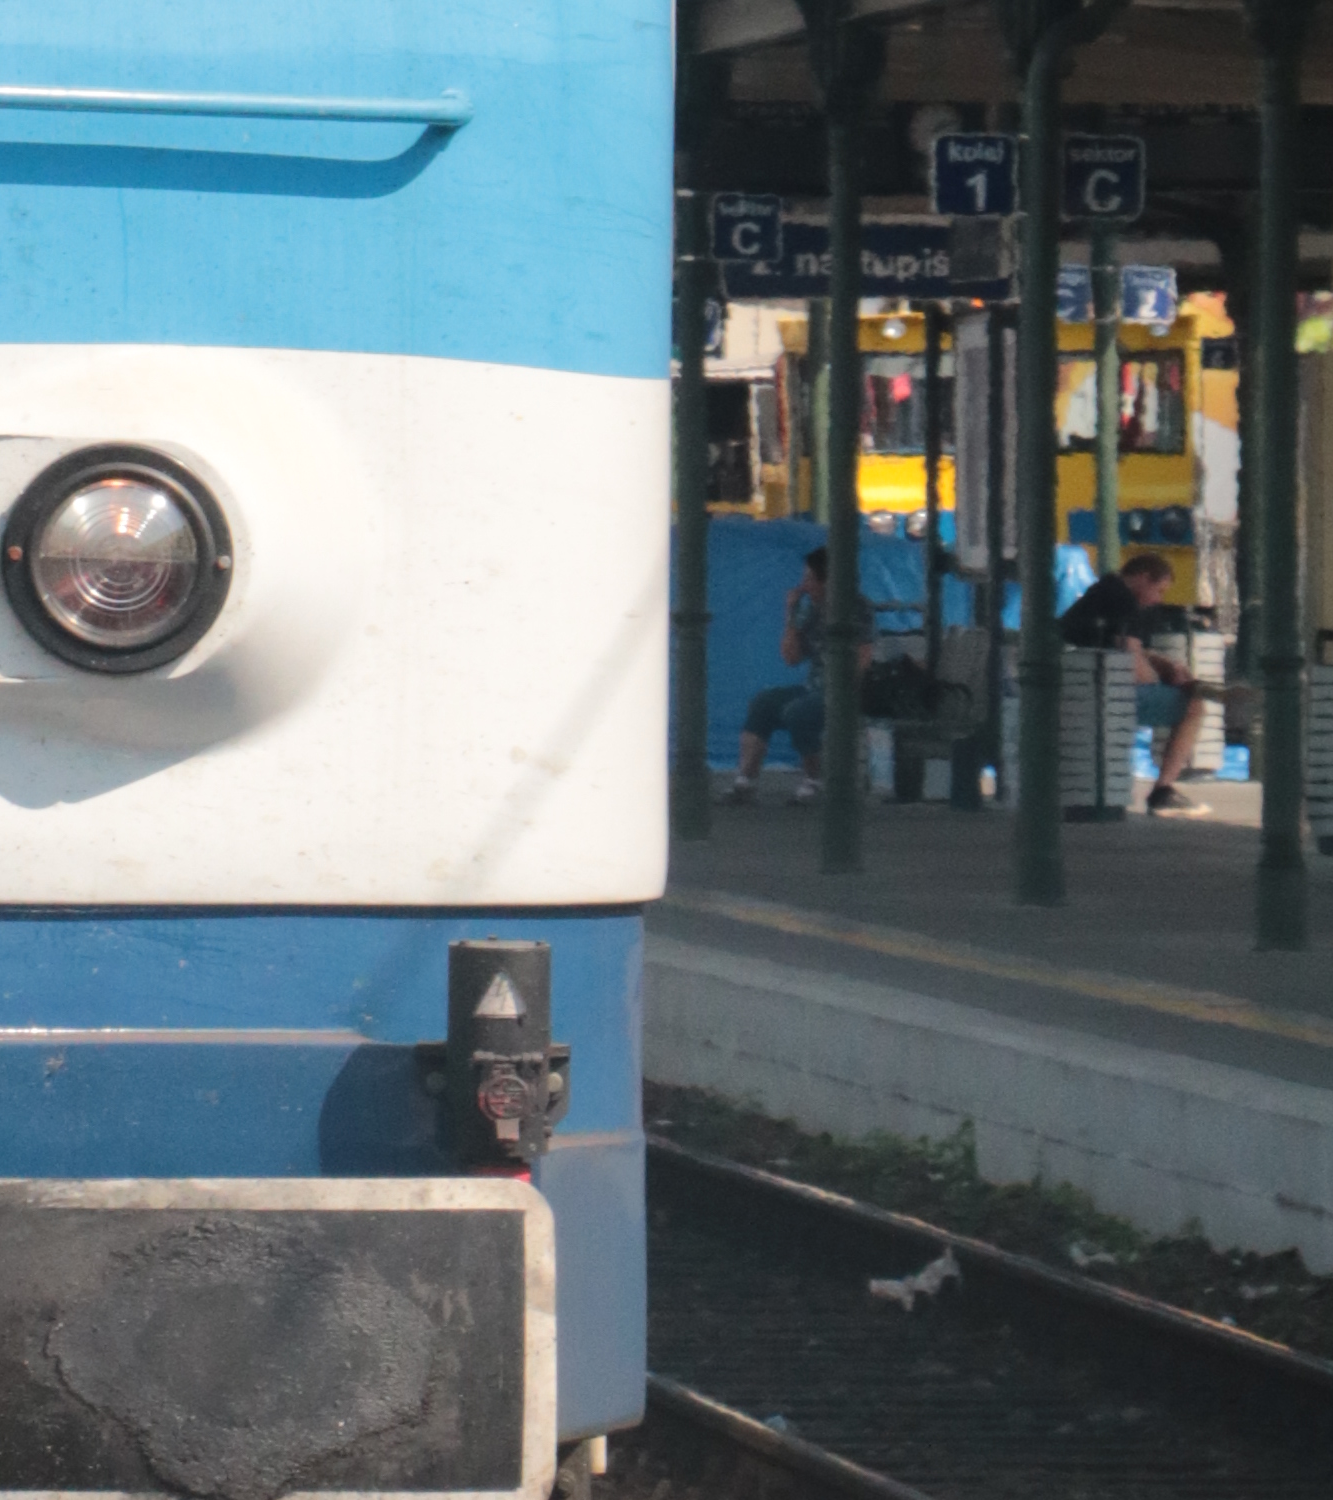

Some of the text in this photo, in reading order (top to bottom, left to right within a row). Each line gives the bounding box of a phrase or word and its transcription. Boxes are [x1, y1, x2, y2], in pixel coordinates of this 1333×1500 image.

[965, 169, 988, 211] 1
[1085, 168, 1123, 213] C
[731, 221, 761, 255] C
